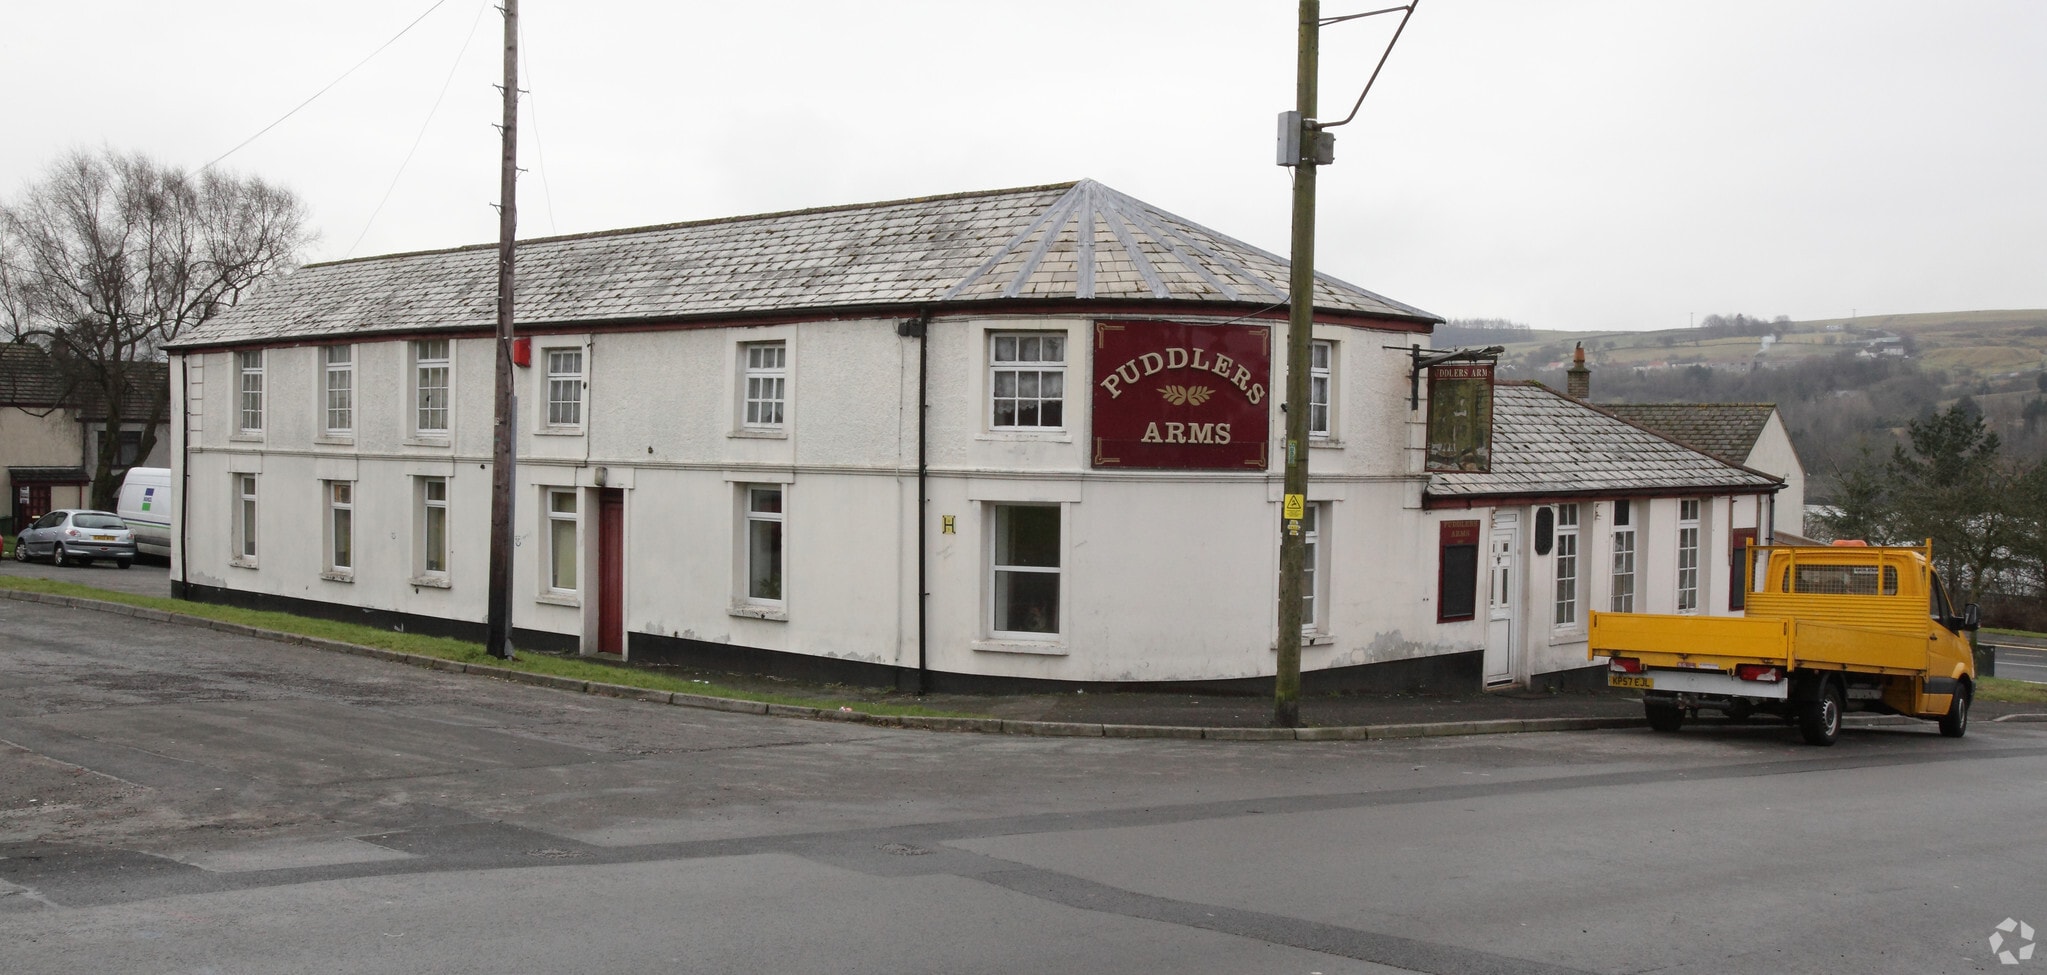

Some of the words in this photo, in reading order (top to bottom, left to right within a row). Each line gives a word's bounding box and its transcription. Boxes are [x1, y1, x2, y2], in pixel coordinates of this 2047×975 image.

[1100, 347, 1266, 405] PUDDLERS
[1141, 421, 1231, 445] ARMS
[942, 515, 956, 534] H
[1612, 676, 1632, 686] KP57
[1634, 678, 1650, 688] EJL
